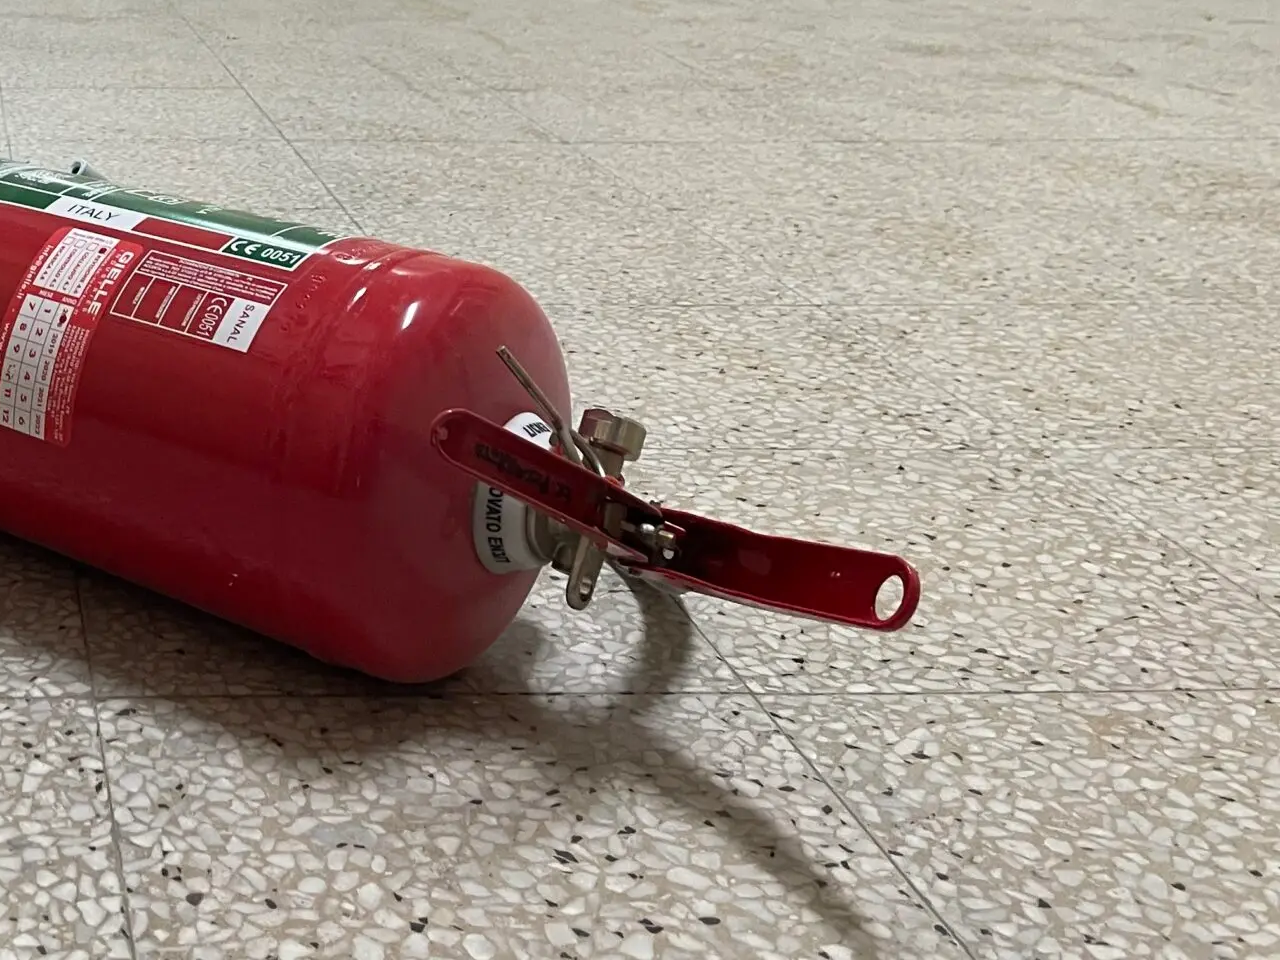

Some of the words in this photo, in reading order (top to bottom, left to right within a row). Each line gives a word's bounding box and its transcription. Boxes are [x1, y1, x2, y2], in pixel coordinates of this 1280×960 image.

[67, 203, 120, 221] ITALY
[261, 244, 302, 264] 0051
[88, 251, 135, 314] GIELLE
[226, 304, 255, 343] SANAL
[47, 332, 58, 354] 2019
